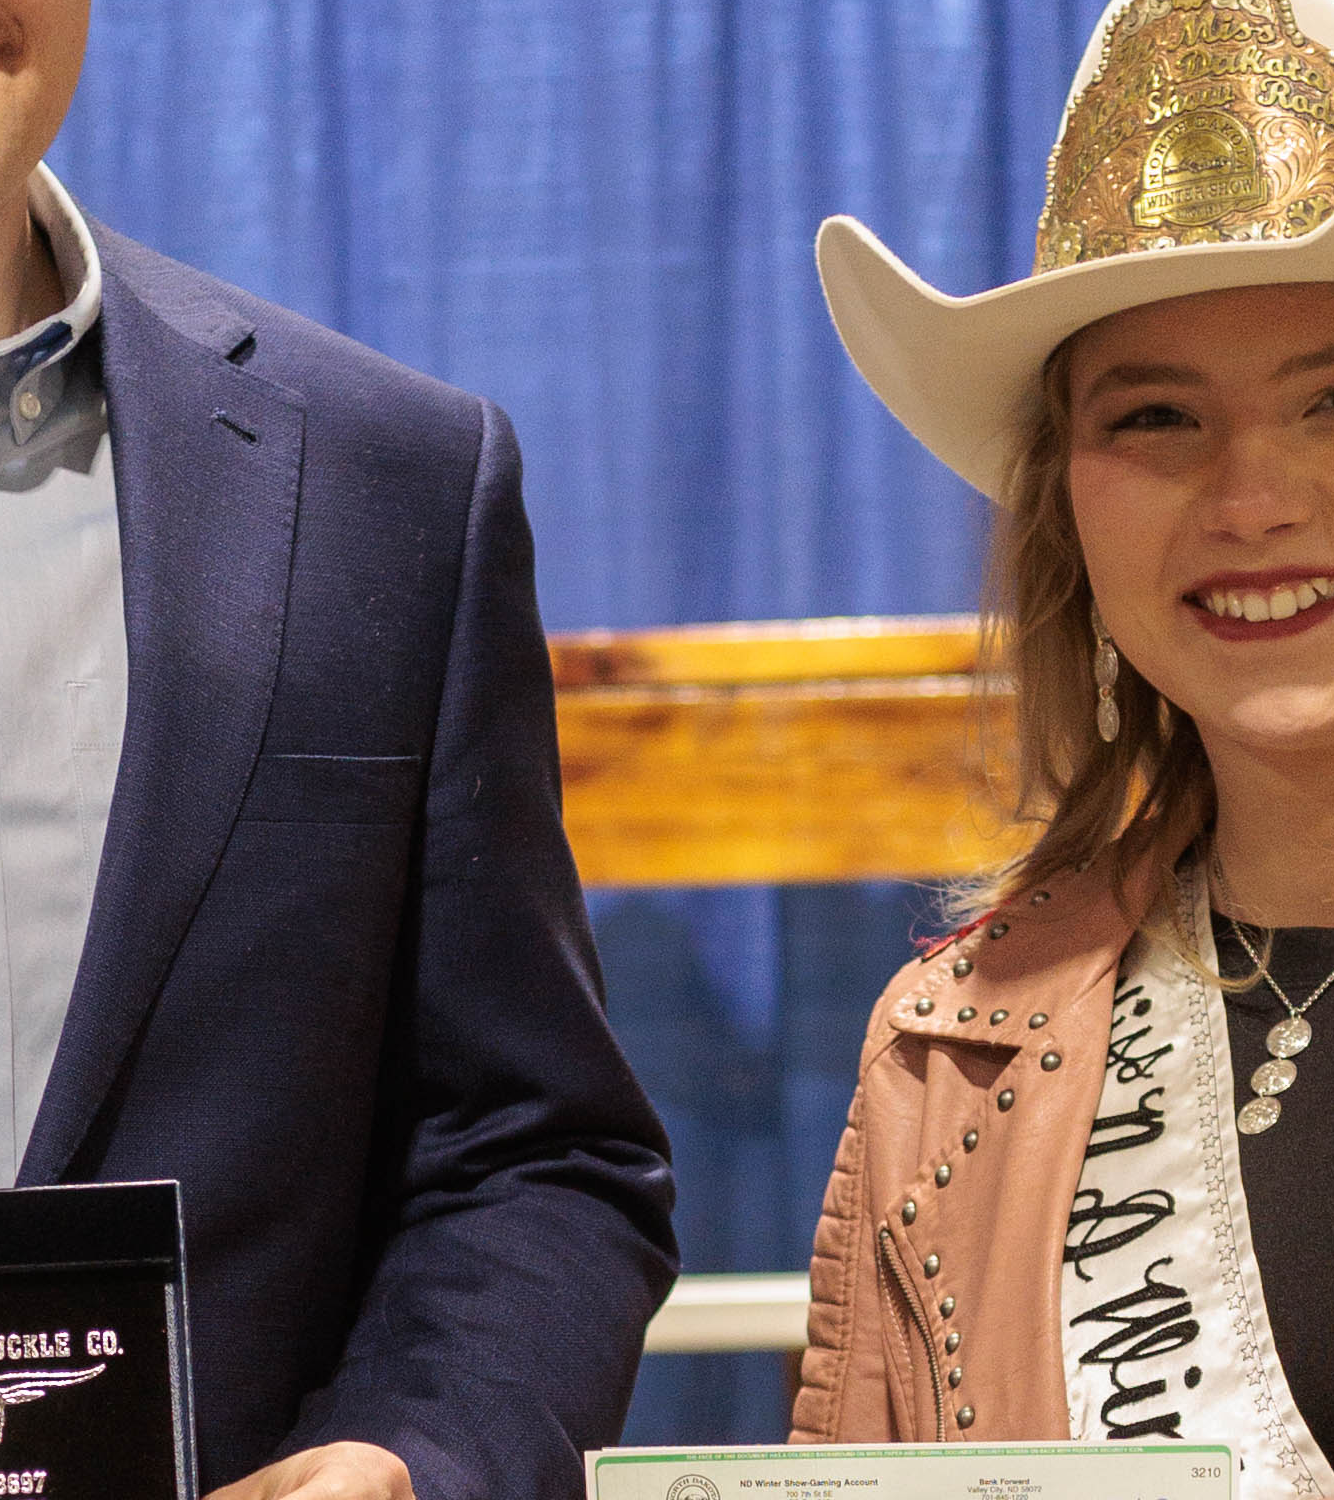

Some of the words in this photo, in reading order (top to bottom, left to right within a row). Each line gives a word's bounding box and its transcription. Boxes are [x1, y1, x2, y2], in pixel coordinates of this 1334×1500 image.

[1167, 12, 1277, 48] Miss
[1148, 119, 1187, 185] NORTH
[1193, 115, 1249, 170] DAKOTA
[1145, 185, 1204, 208] WINTER
[1209, 177, 1254, 197] SHOW
[86, 1330, 124, 1357] CO.
[979, 1478, 997, 1486] Bank
[1000, 1477, 1030, 1485] Forward
[1191, 1467, 1221, 1479] 3210
[740, 1479, 752, 1487] ND
[755, 1479, 781, 1487] Winter
[784, 1479, 841, 1488] Show-Gaming
[844, 1478, 879, 1486] Account
[967, 1485, 987, 1493] Valley
[1021, 1485, 1042, 1493] 58072
